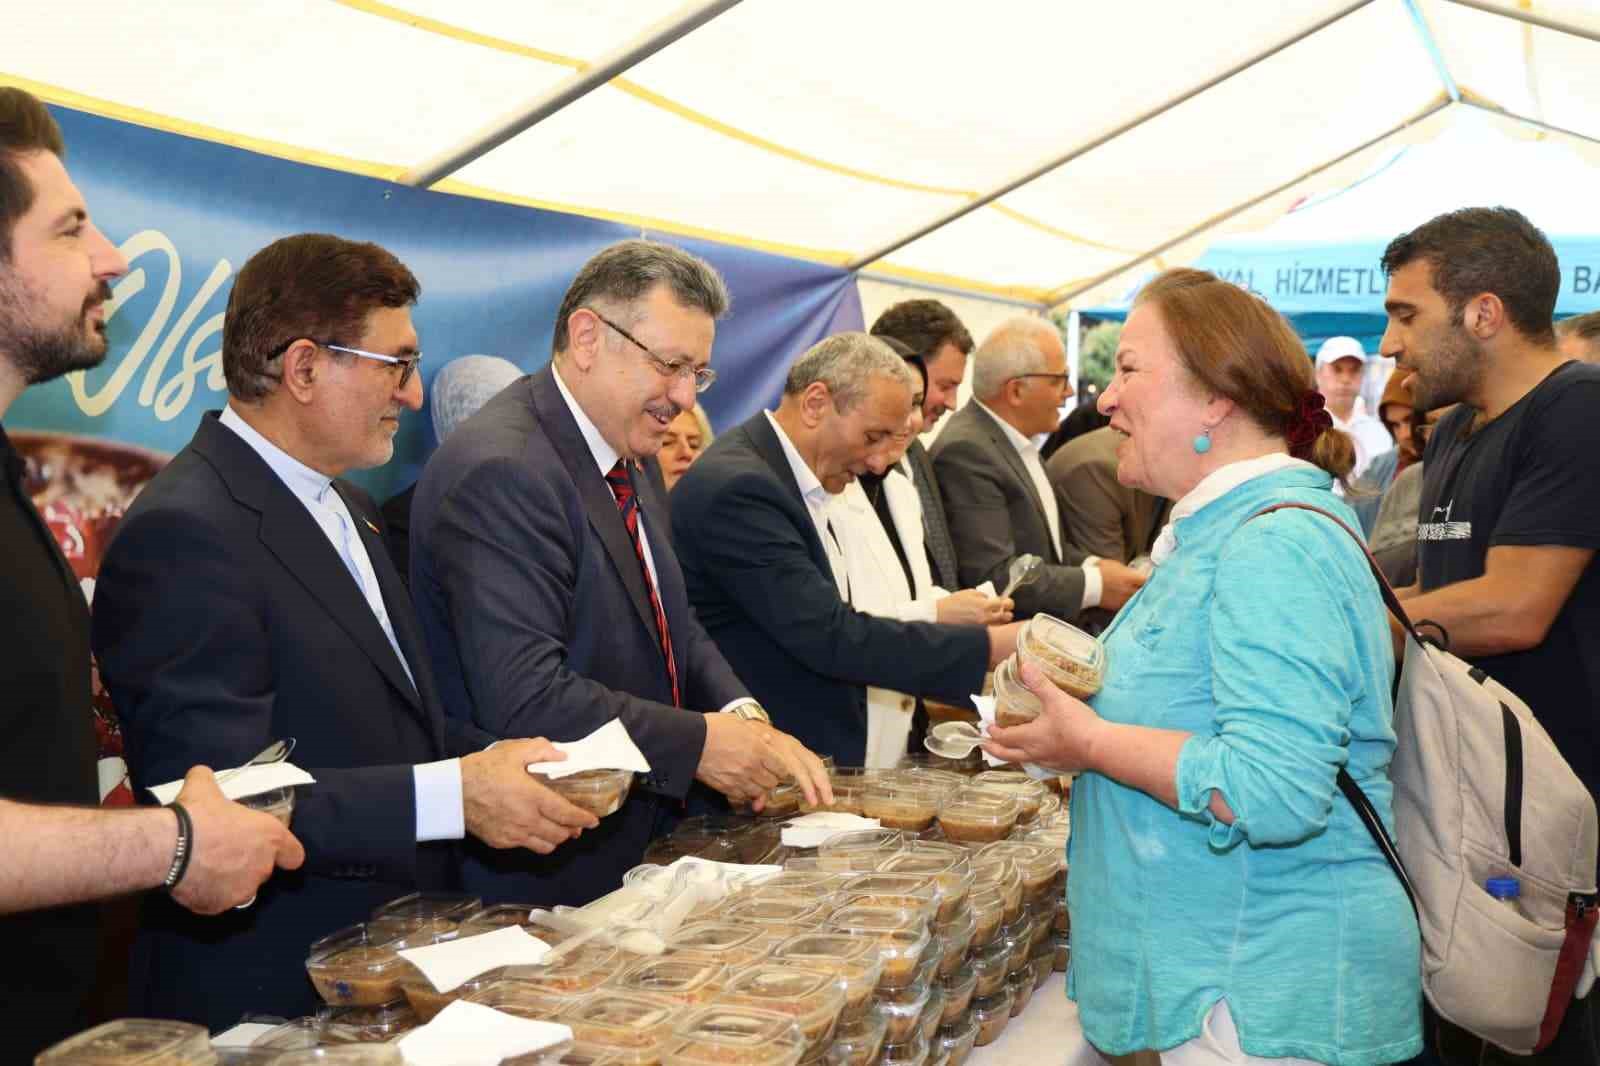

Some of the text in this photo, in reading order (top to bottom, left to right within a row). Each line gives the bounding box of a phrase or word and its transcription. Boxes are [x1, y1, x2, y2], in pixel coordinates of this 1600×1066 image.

[65, 229, 231, 421] Ols
[1209, 267, 1263, 296] YAL
[1275, 261, 1387, 296] HİZMETL
